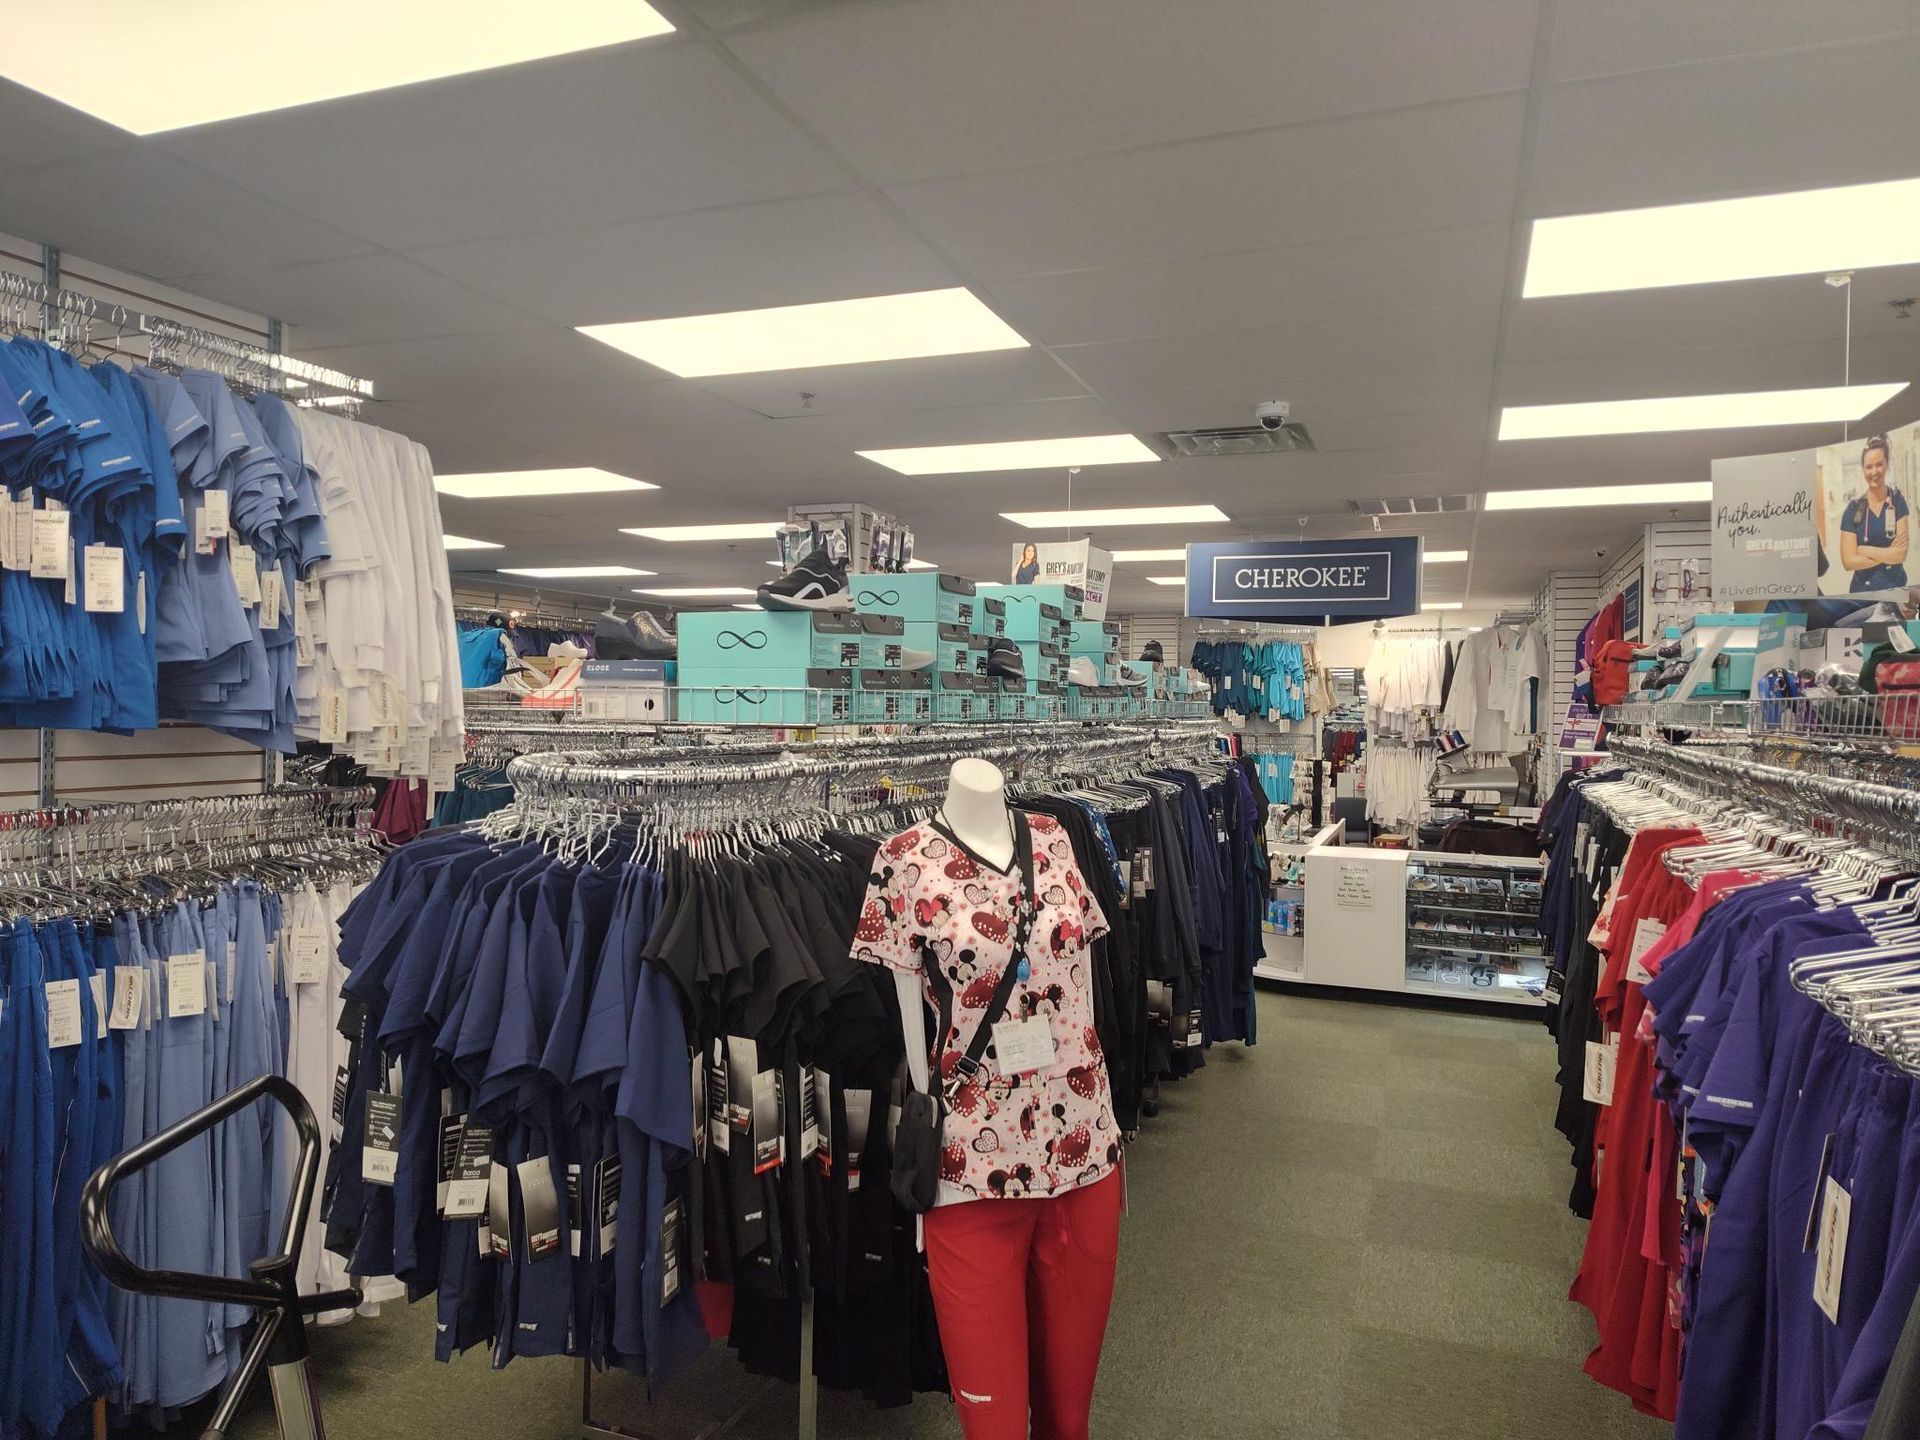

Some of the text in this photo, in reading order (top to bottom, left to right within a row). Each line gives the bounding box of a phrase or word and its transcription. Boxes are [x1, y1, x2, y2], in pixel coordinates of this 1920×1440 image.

[1717, 490, 1812, 529] Authentically
[1728, 525, 1761, 549] you.
[1046, 561, 1067, 574] GREY'S
[1235, 566, 1367, 589] CHEROKEE
[1719, 583, 1807, 596] #LiveInGreys
